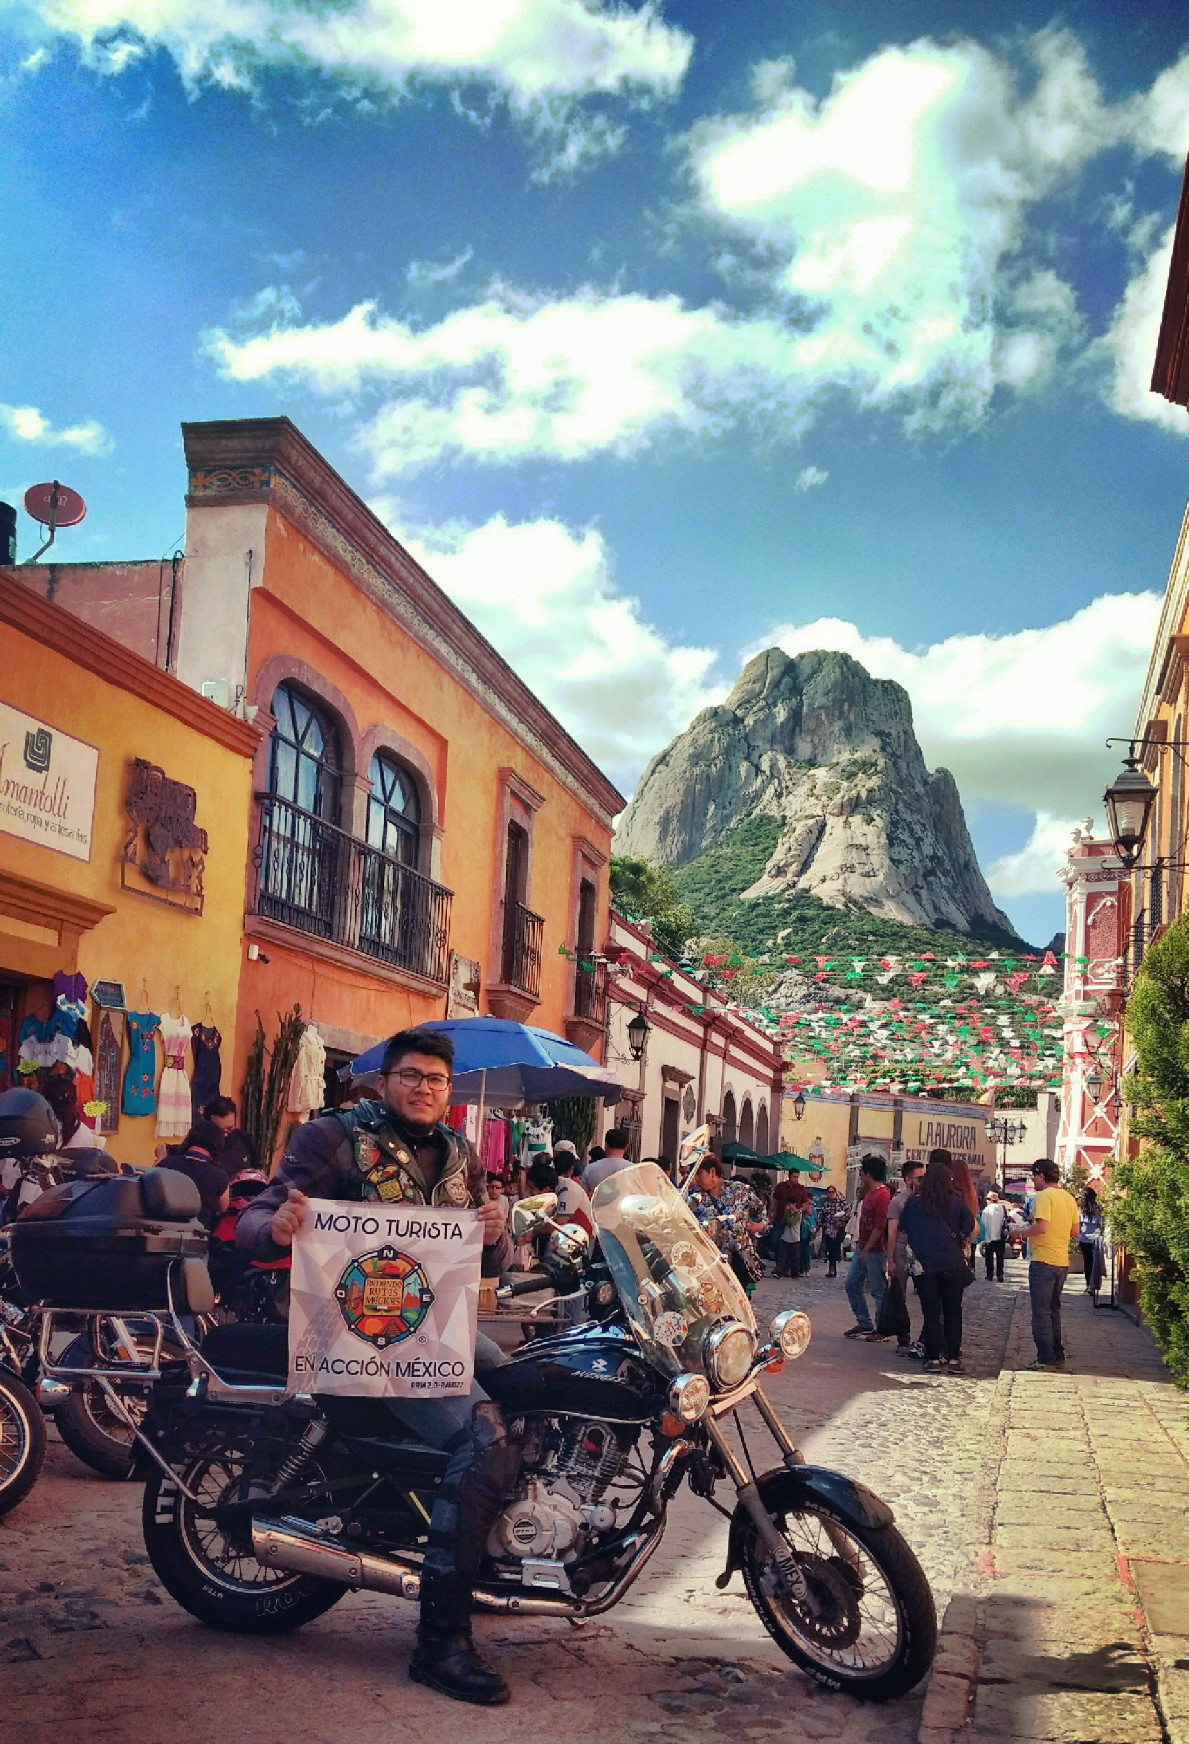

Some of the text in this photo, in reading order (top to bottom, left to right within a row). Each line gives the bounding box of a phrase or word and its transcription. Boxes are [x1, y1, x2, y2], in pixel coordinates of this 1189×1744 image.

[314, 1213, 463, 1240] MOTO TURISTA
[383, 1249, 394, 1258] N
[295, 1355, 466, 1378] EN ACCIÓN MÉXICO
[778, 1556, 803, 1588] MEX
